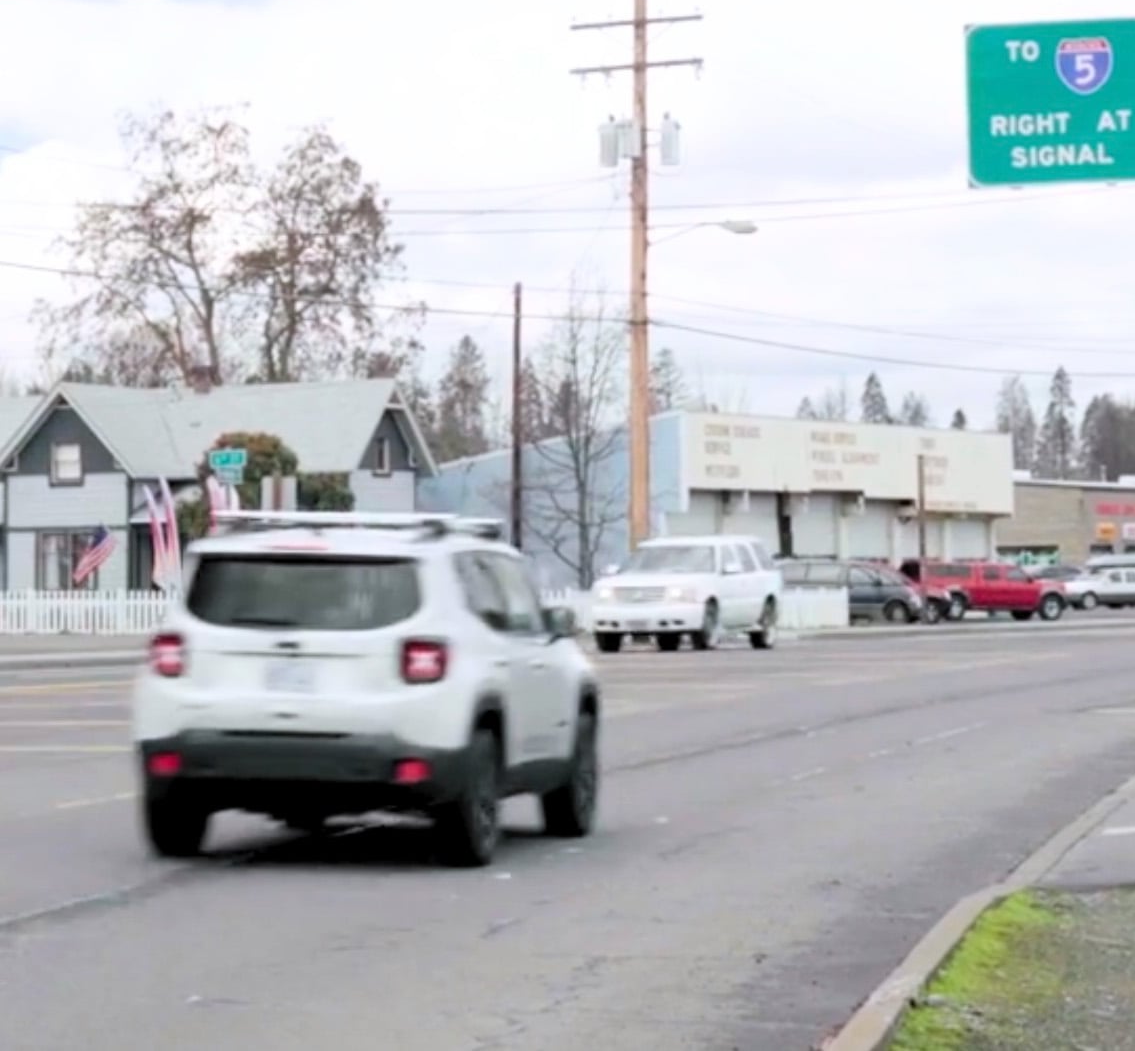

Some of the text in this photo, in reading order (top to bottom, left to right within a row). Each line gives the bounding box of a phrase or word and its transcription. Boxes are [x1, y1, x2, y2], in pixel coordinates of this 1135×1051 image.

[1005, 40, 1040, 63] TO
[1075, 54, 1096, 85] 5
[990, 109, 1131, 137] RIGHT AT
[1010, 143, 1114, 169] SIGNAL
